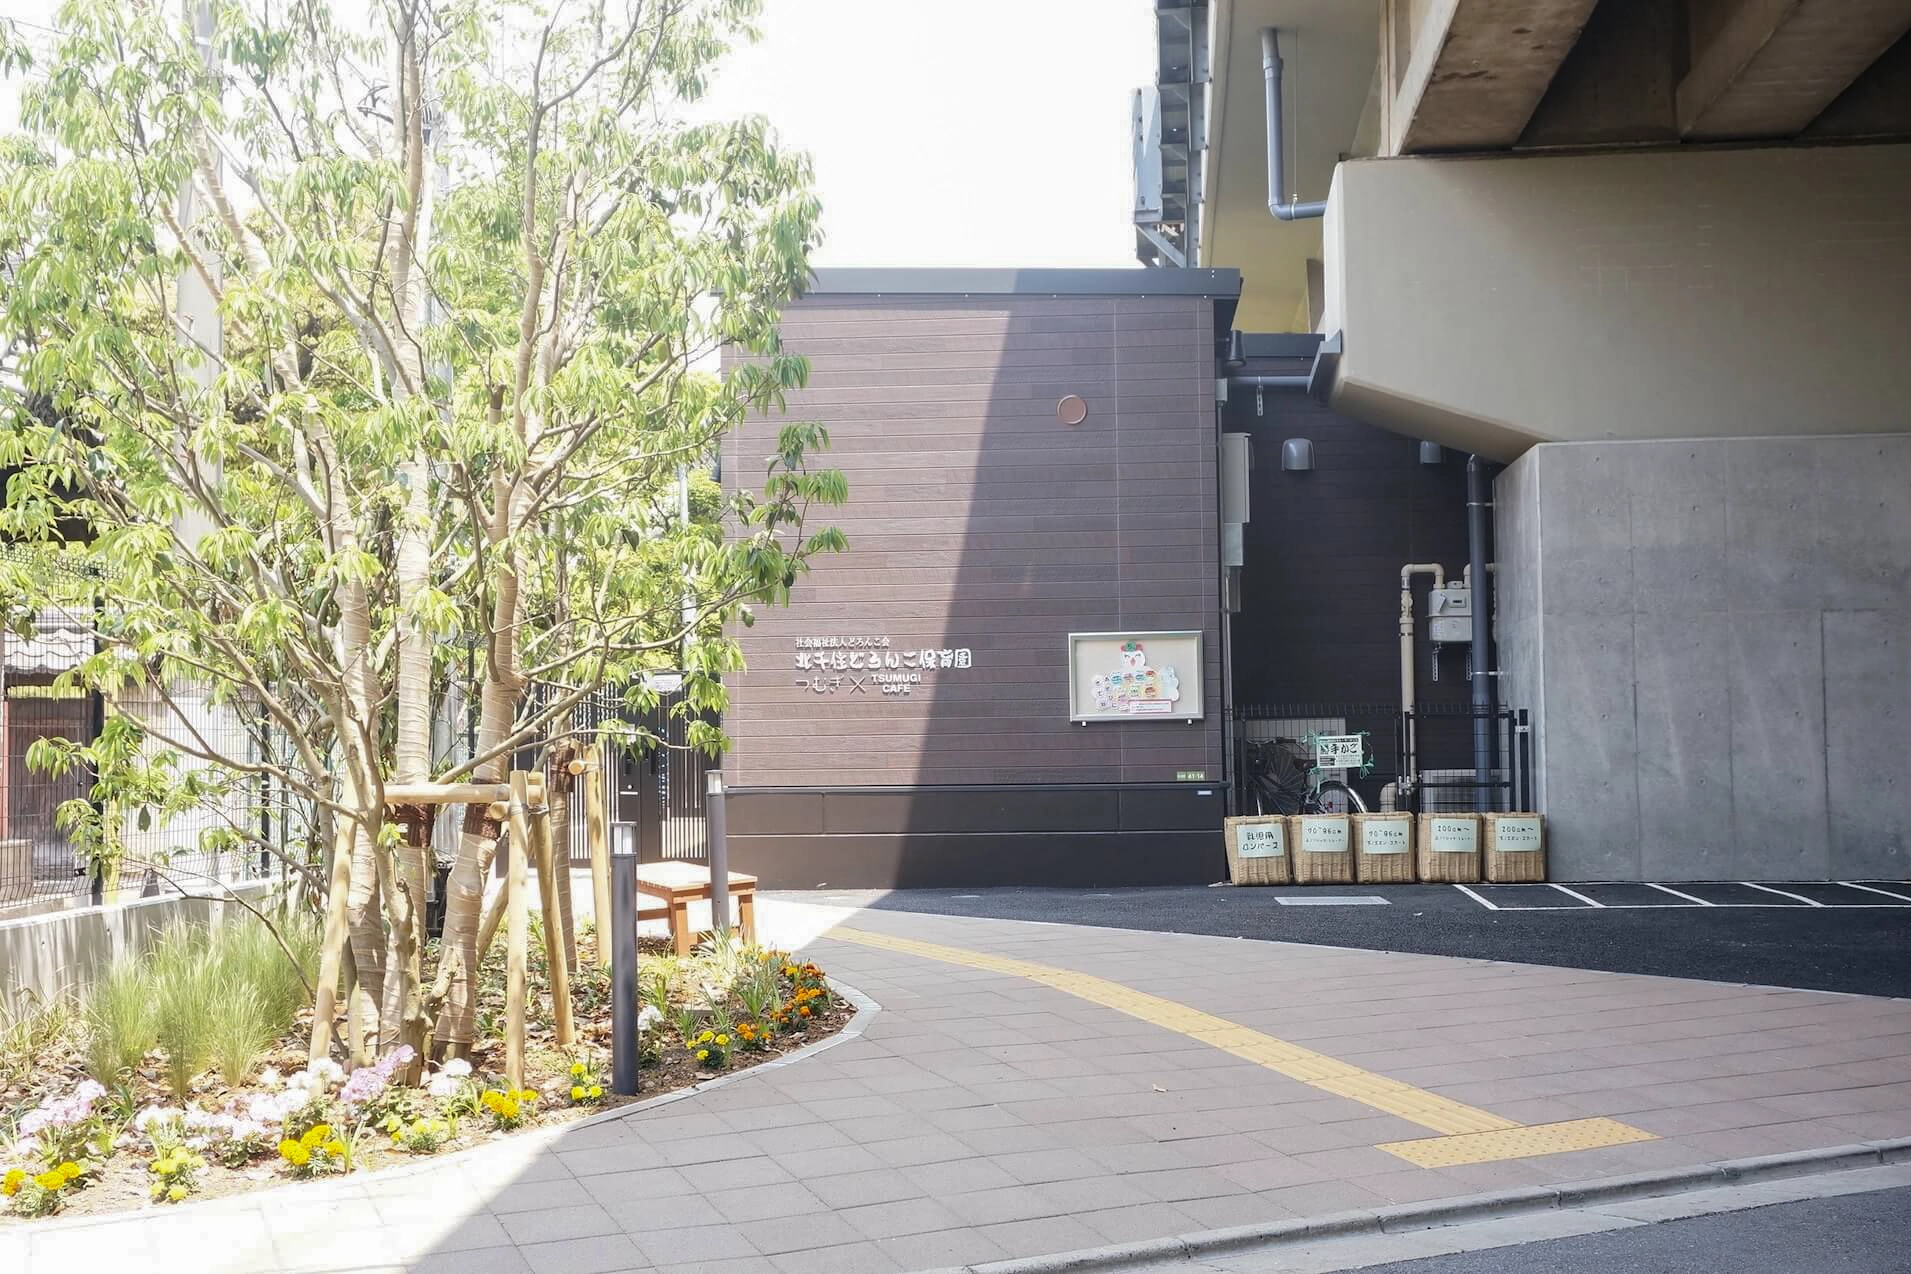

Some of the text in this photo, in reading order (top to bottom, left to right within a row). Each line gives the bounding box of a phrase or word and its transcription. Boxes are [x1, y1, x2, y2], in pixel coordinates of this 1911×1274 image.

[795, 649, 972, 669] 北千住どろんこ保育園
[795, 676, 843, 692] つむぎ
[871, 673, 921, 683] TSUMUGI
[882, 684, 911, 693] CAFE
